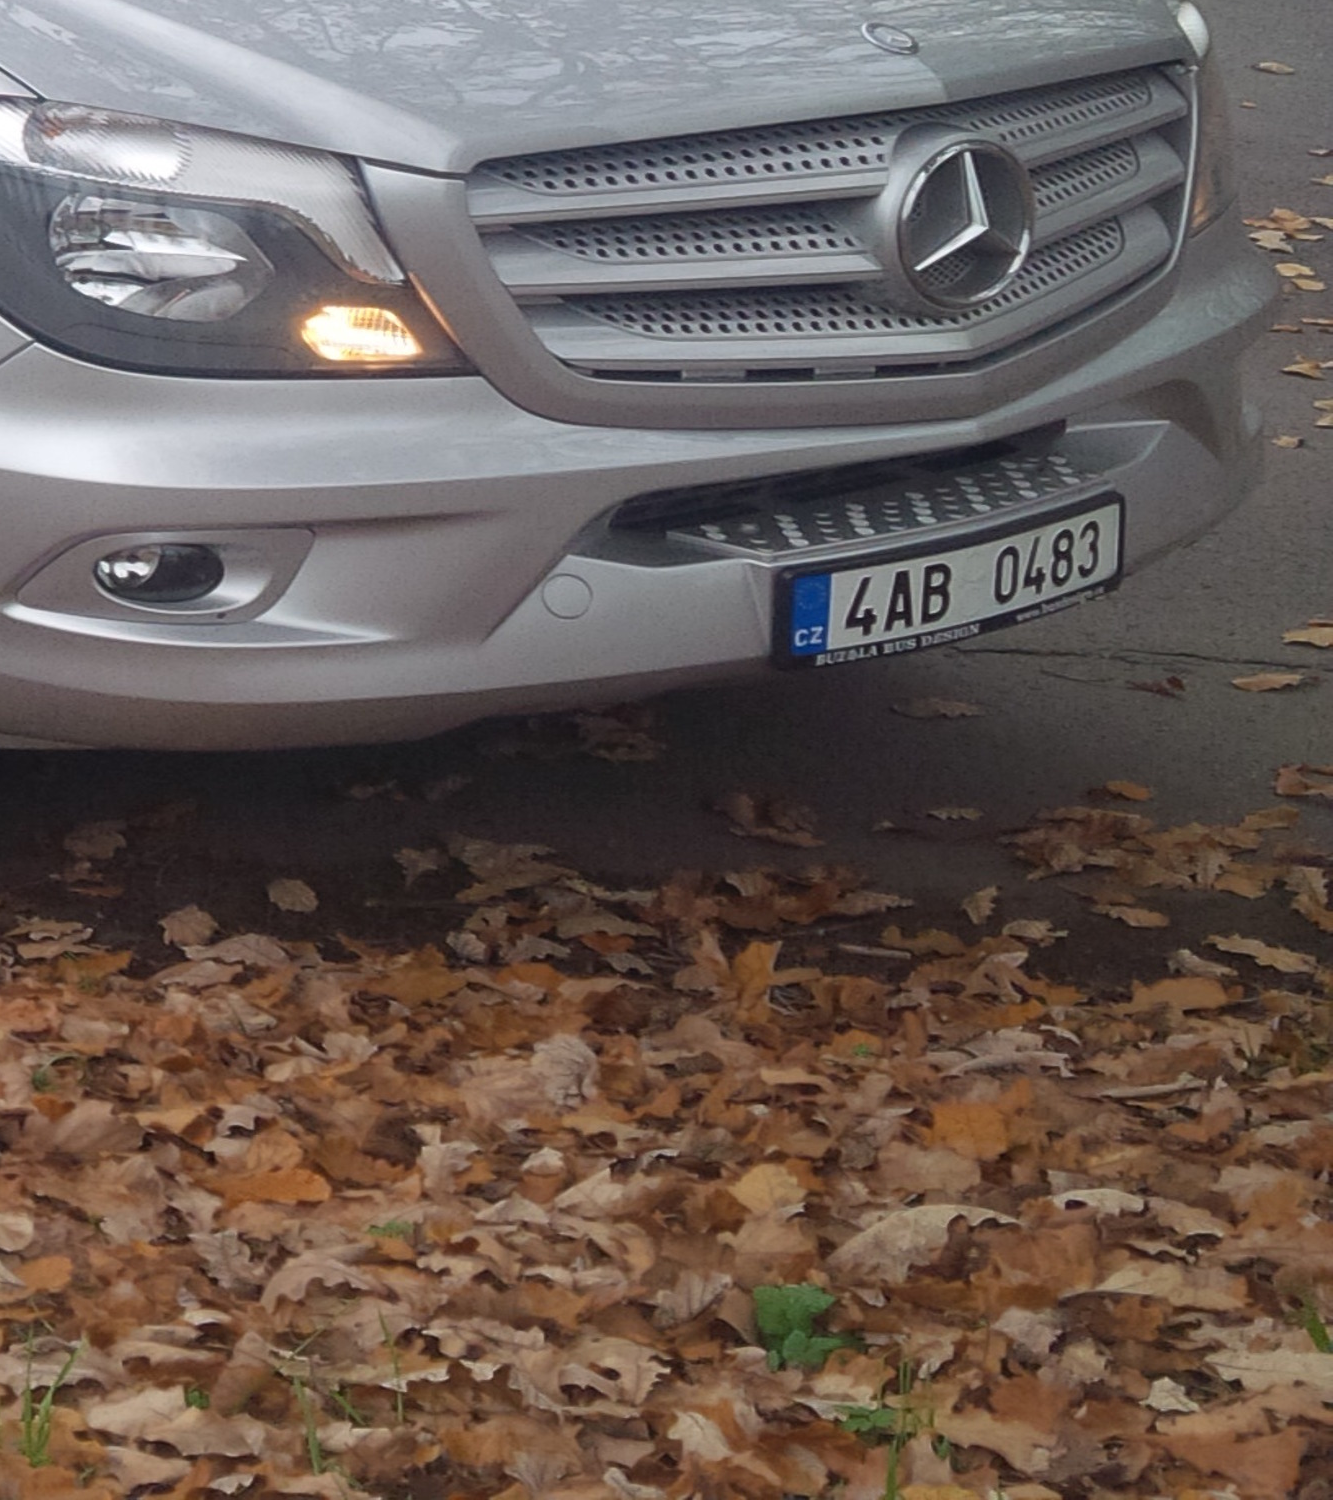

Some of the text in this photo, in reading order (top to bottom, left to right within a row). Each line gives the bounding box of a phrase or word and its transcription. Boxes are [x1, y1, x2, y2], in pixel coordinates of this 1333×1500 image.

[794, 626, 823, 648] CZ
[844, 562, 952, 637] 4AB
[993, 519, 1101, 605] 0483
[882, 638, 917, 654] BUS
[920, 623, 982, 648] DESIGN
